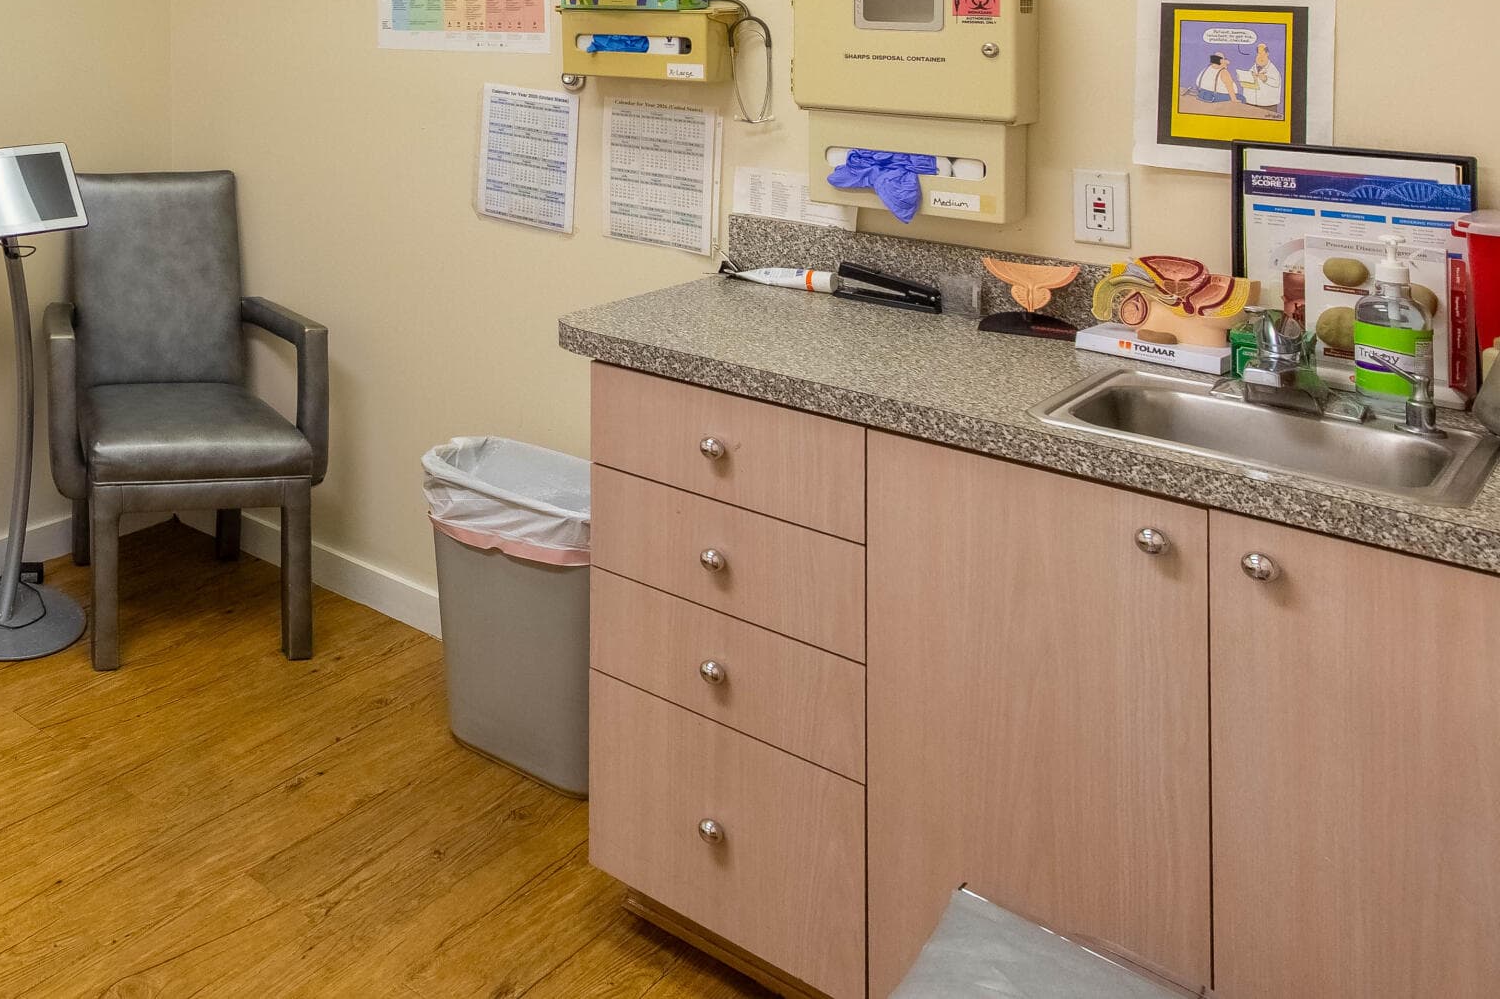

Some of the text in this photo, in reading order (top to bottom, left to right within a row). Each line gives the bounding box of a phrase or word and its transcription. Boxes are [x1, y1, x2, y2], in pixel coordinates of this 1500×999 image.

[906, 55, 946, 63] CONTAINER
[1251, 179, 1282, 188] SCORE
[933, 197, 969, 208] Medium
[1133, 343, 1176, 358] TOLMAR
